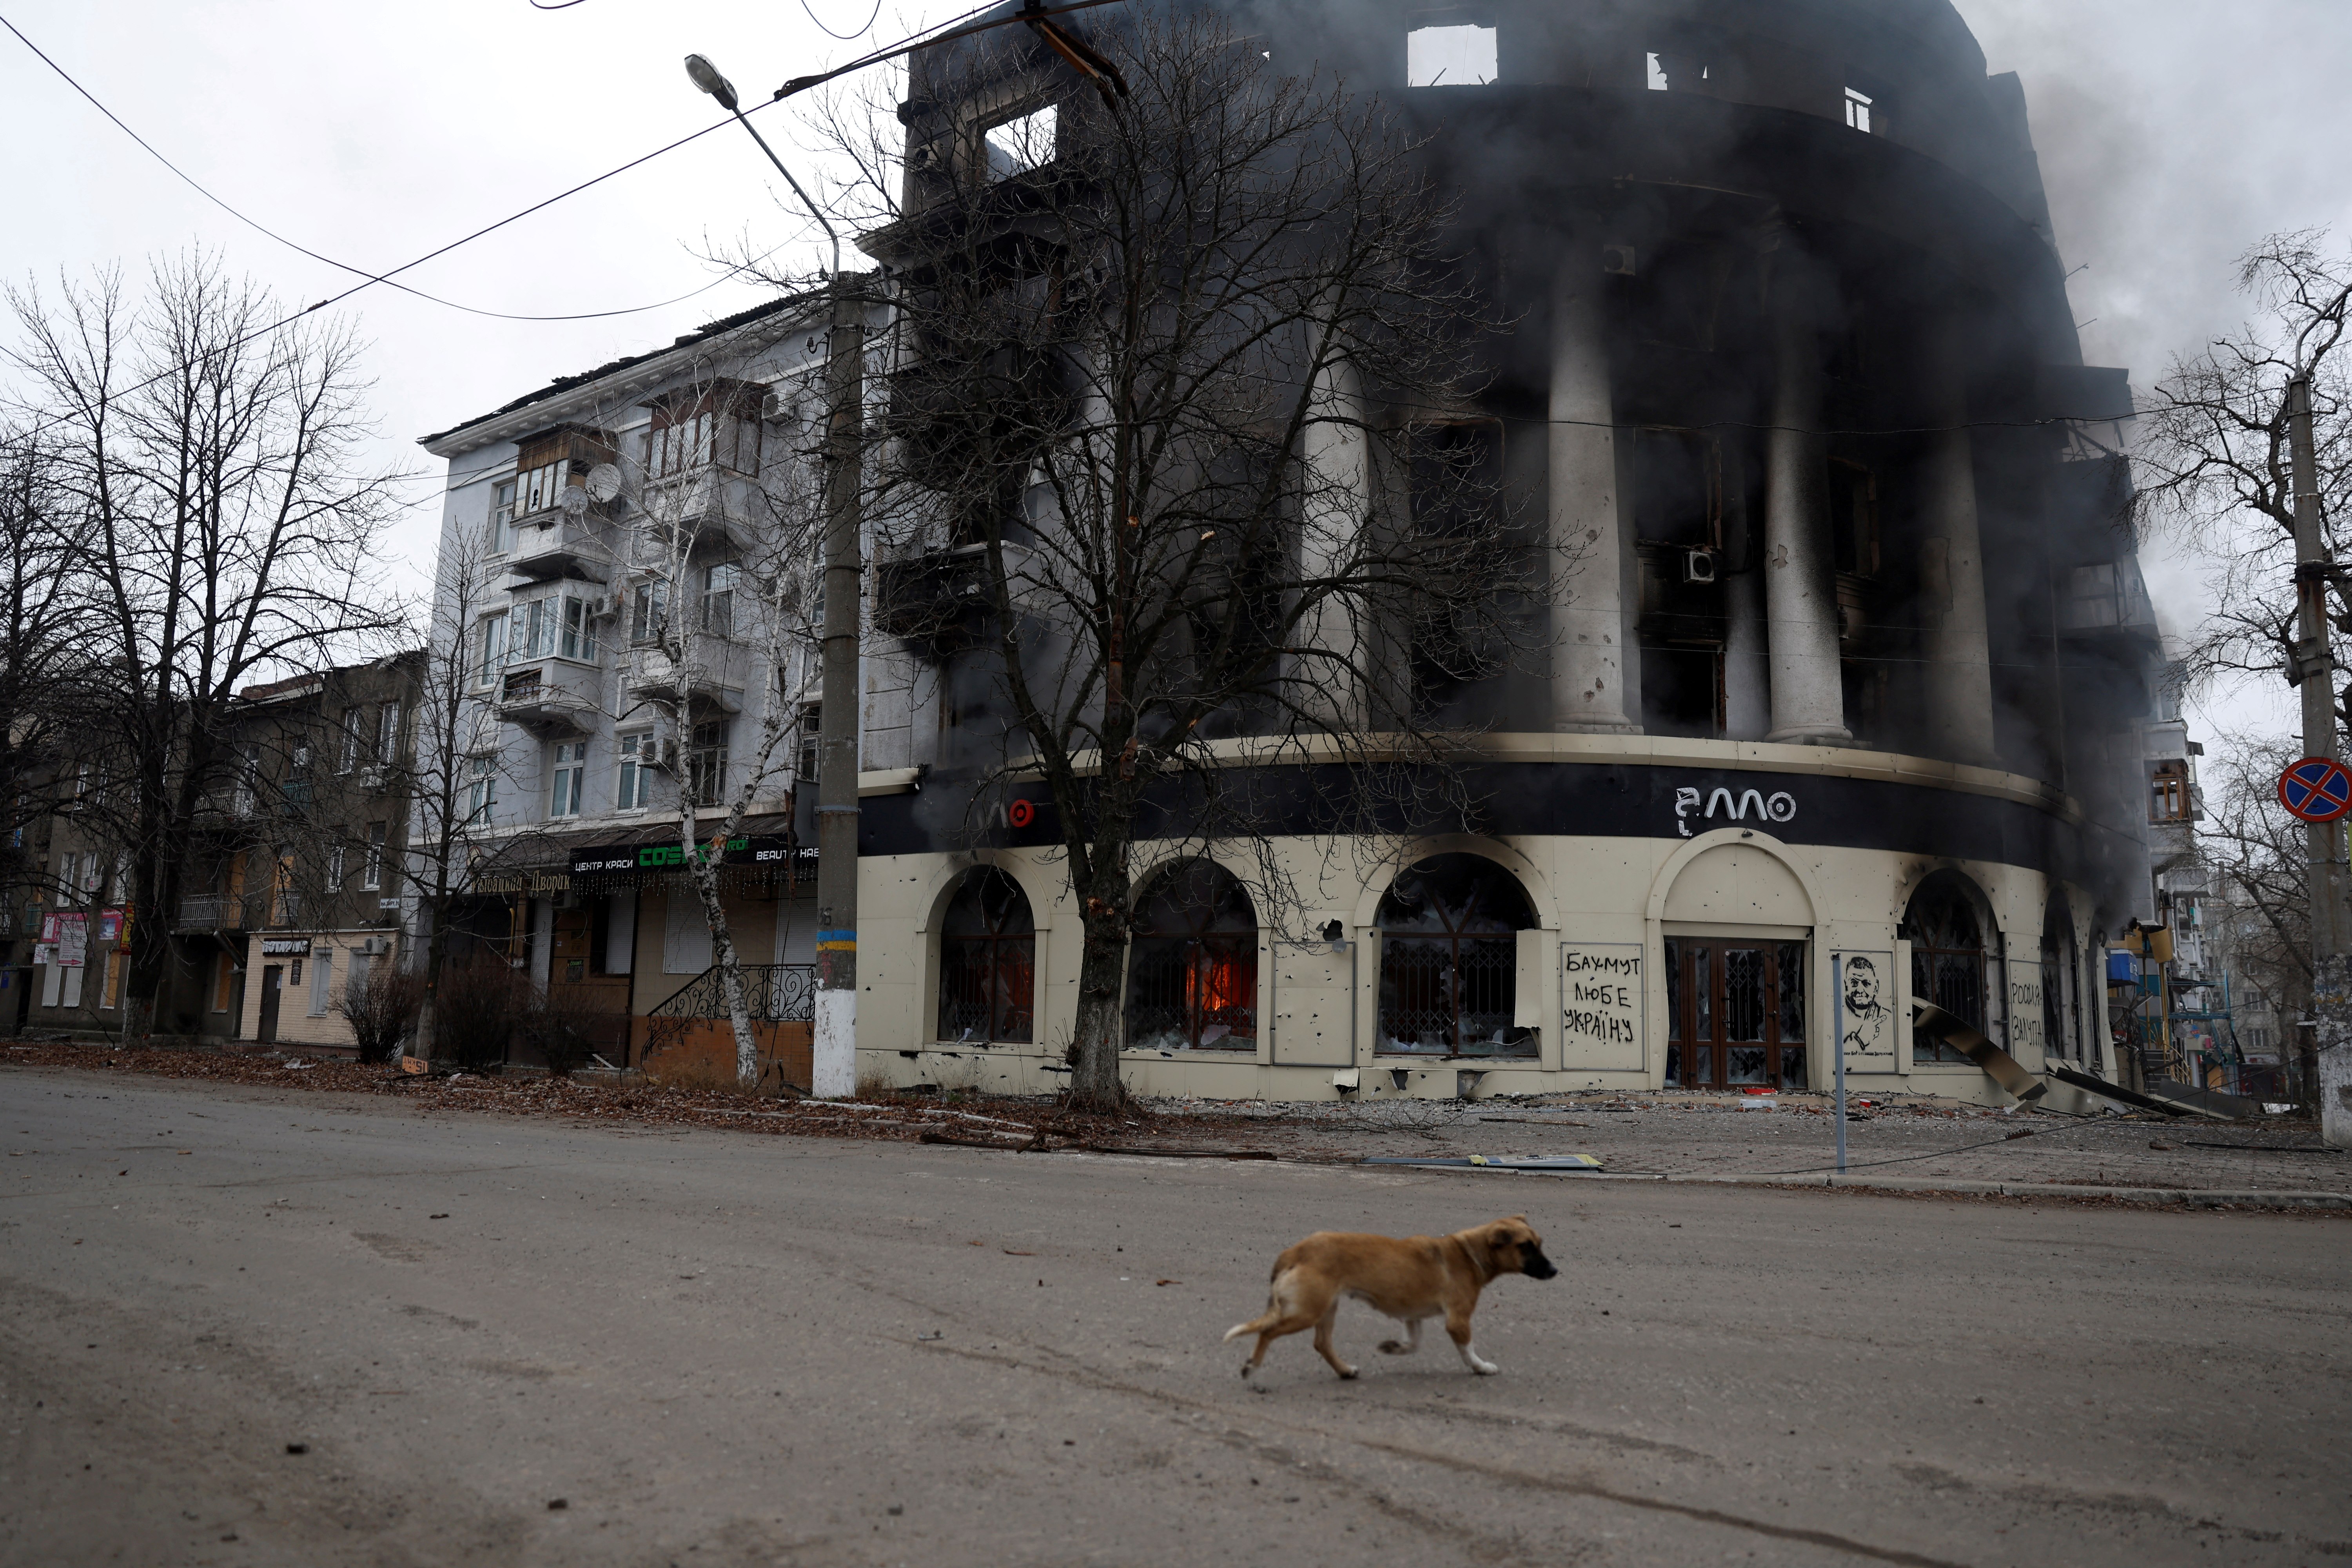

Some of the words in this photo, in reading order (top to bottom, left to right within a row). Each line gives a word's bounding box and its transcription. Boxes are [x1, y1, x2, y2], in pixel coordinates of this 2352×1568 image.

[726, 840, 748, 851] RO
[575, 861, 603, 872] ЦЕНТР
[606, 859, 633, 869] КРАСИ
[530, 869, 570, 897] Дворик
[1567, 953, 1640, 975] БАХМУТ
[1575, 982, 1631, 1007] ЛЮБЕ
[1564, 1009, 1633, 1042] УКРАЇНУ
[2014, 1016, 2042, 1048] ЗАЛУПА
